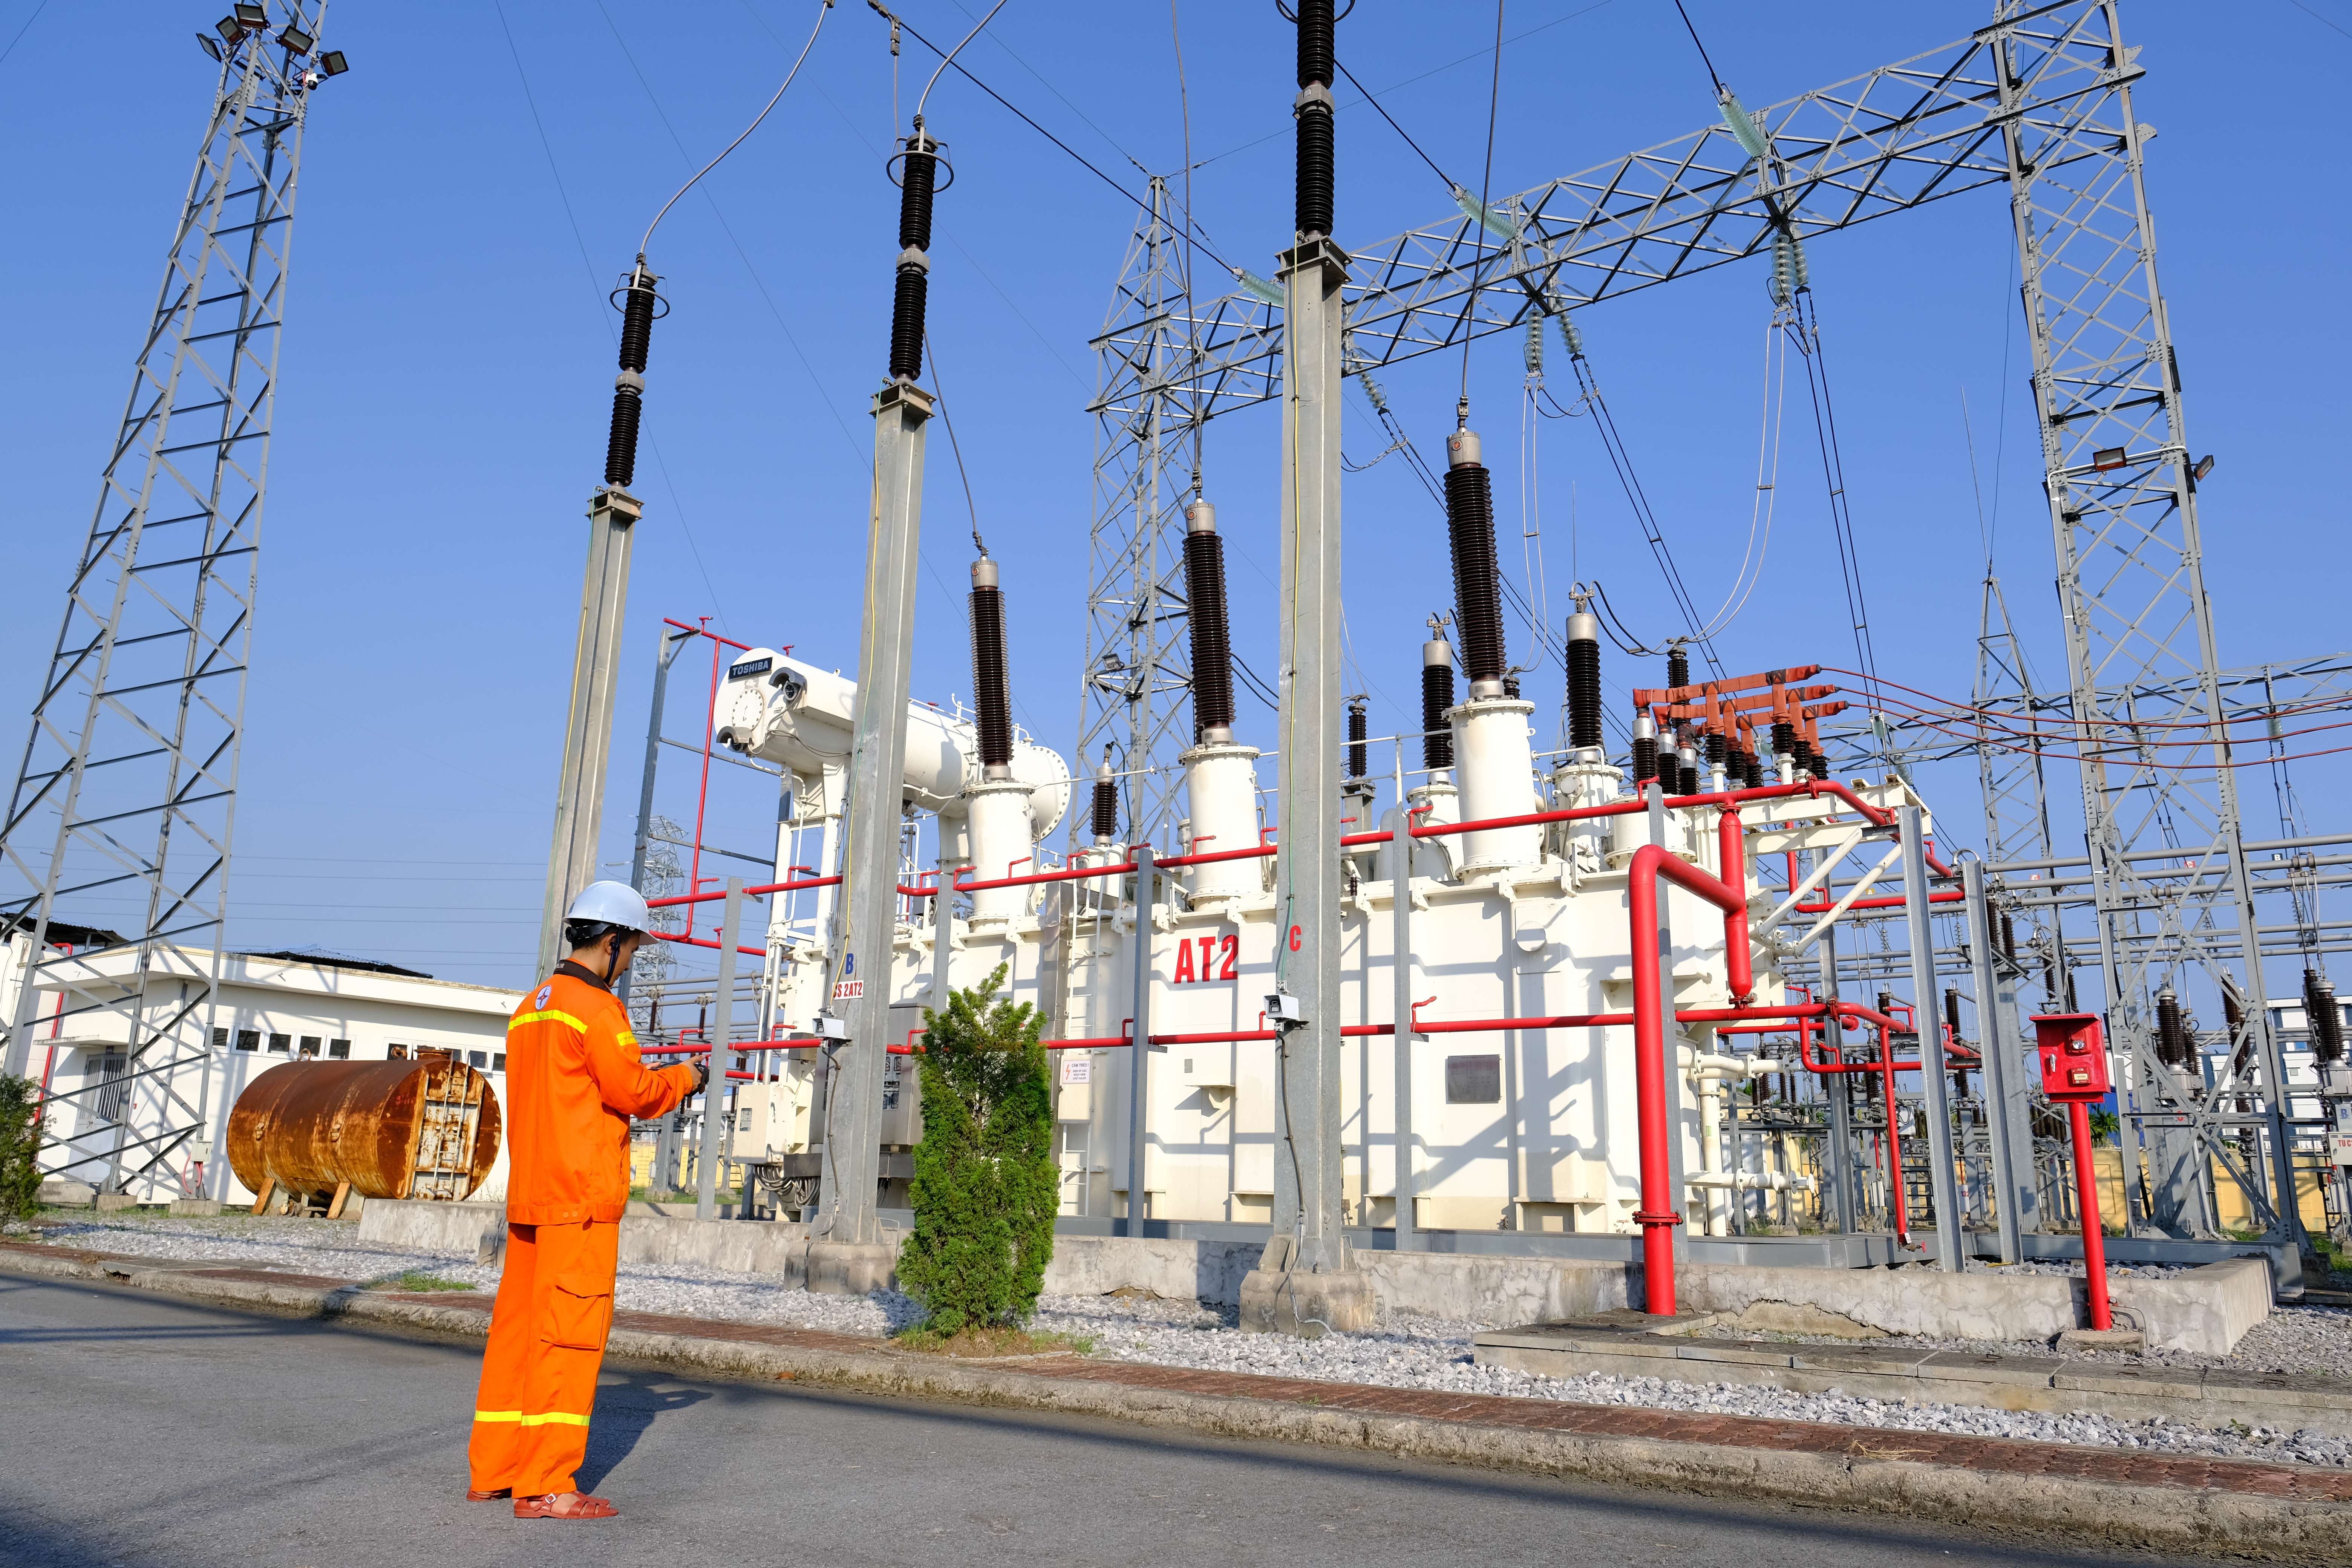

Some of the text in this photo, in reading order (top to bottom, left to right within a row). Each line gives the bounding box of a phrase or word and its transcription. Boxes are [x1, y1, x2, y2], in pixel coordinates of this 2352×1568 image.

[732, 660, 769, 676] TOSHIBA
[1289, 925, 1301, 952] C
[845, 953, 854, 974] B
[1174, 935, 1239, 984] AT2
[844, 982, 862, 997] 2AT2
[2341, 1109, 2348, 1119] B
